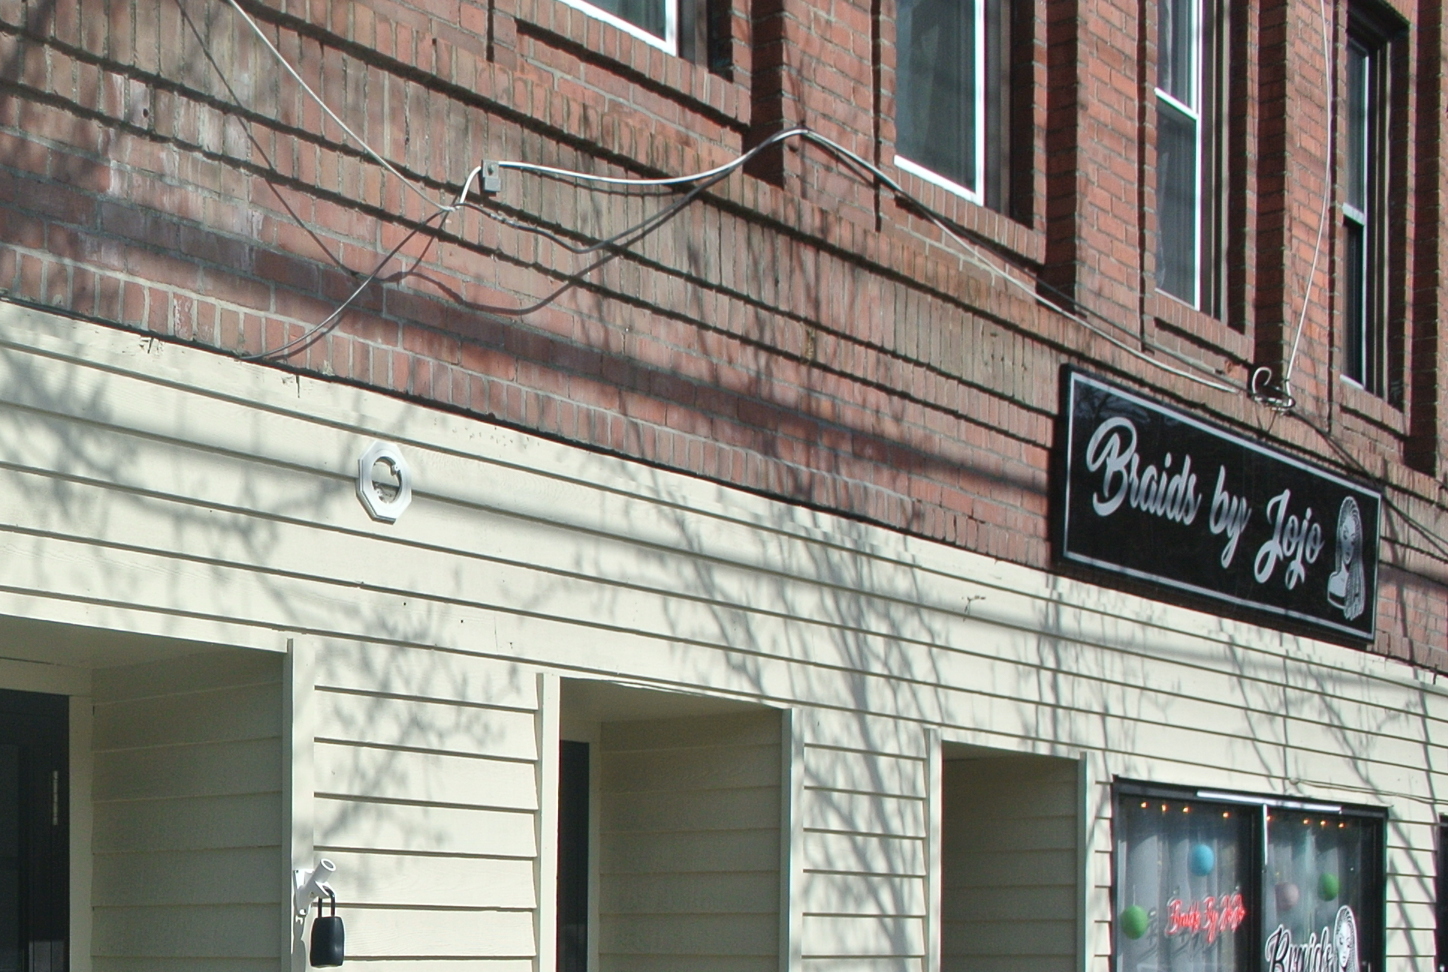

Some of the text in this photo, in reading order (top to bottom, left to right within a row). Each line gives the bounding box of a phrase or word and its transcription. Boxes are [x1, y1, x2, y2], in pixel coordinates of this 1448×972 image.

[1086, 417, 1324, 590] Braids by Jojo
